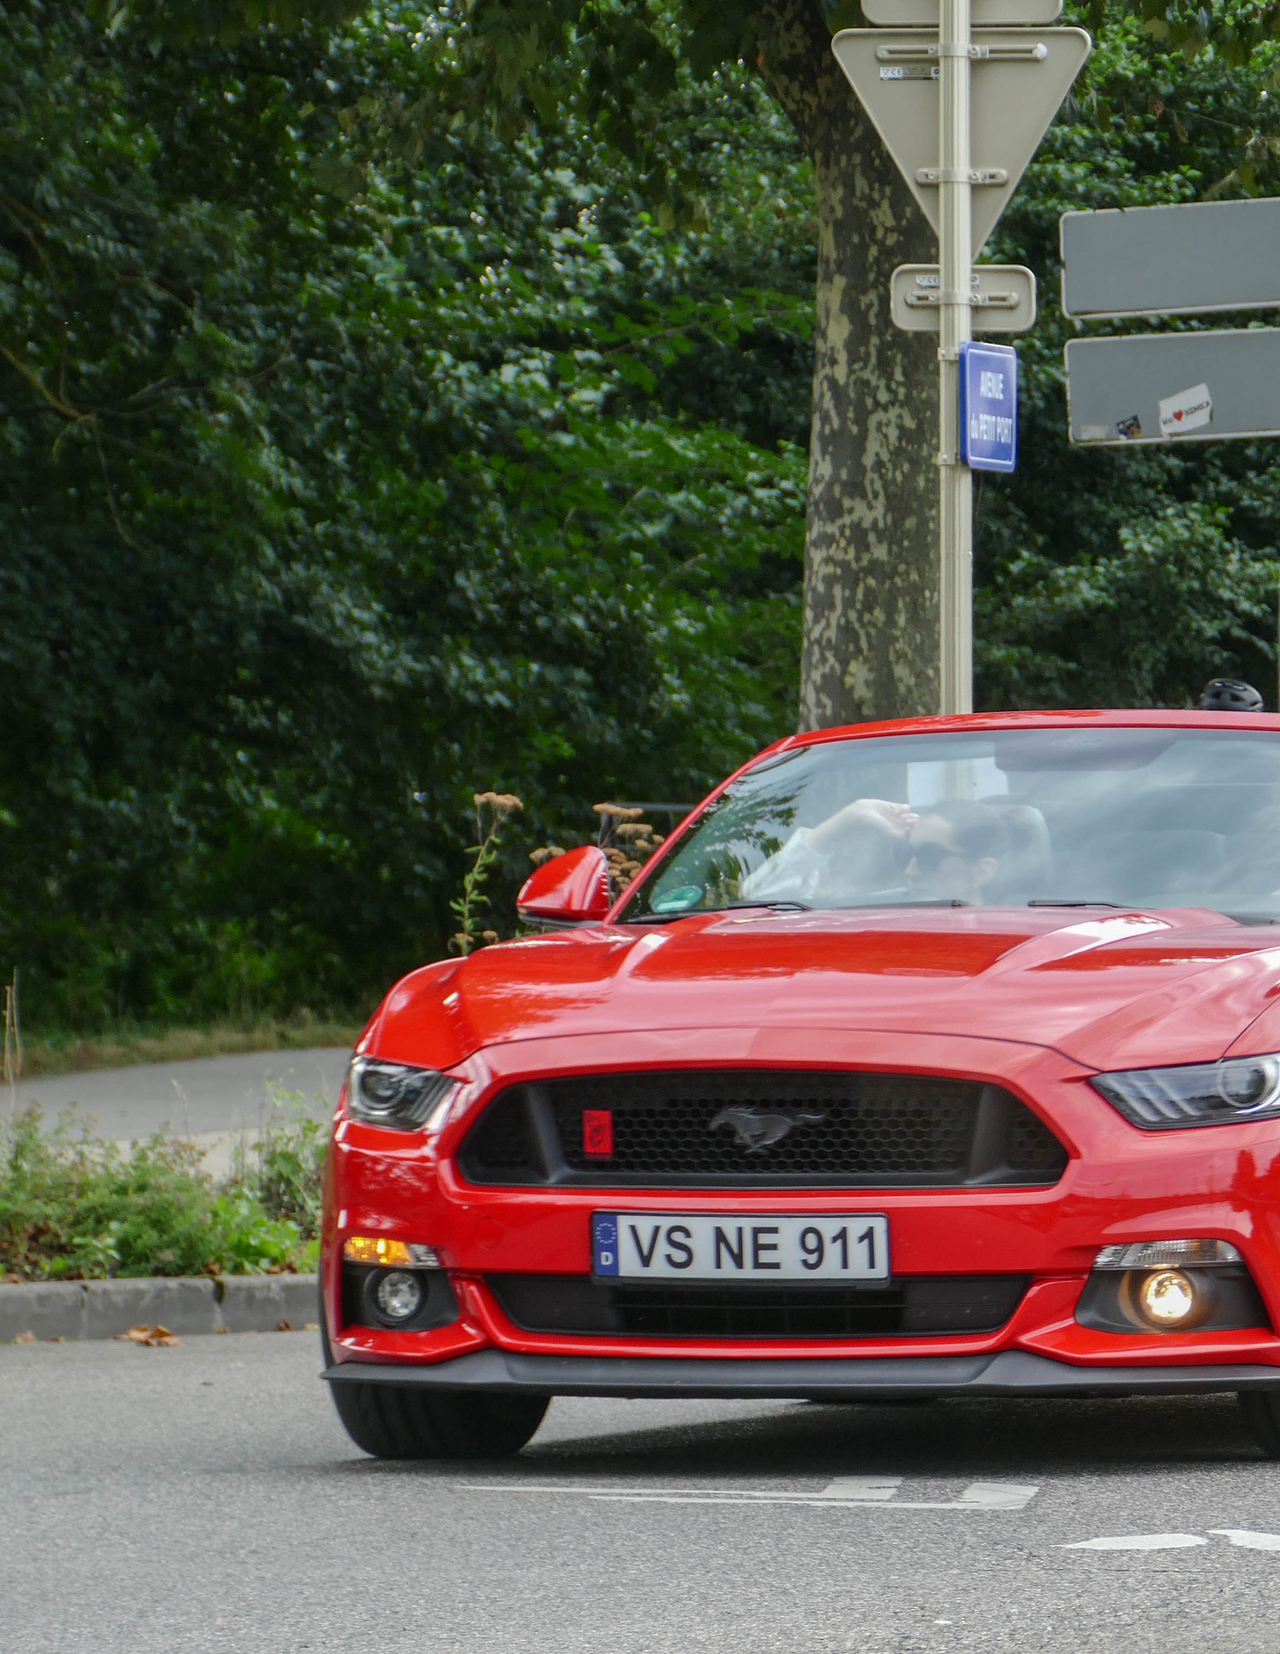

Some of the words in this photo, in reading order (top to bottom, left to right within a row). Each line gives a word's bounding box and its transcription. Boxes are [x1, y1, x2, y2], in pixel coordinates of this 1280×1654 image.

[600, 1251, 614, 1266] D
[628, 1224, 694, 1269] VS
[714, 1225, 781, 1270] NE
[800, 1225, 876, 1271] 911
